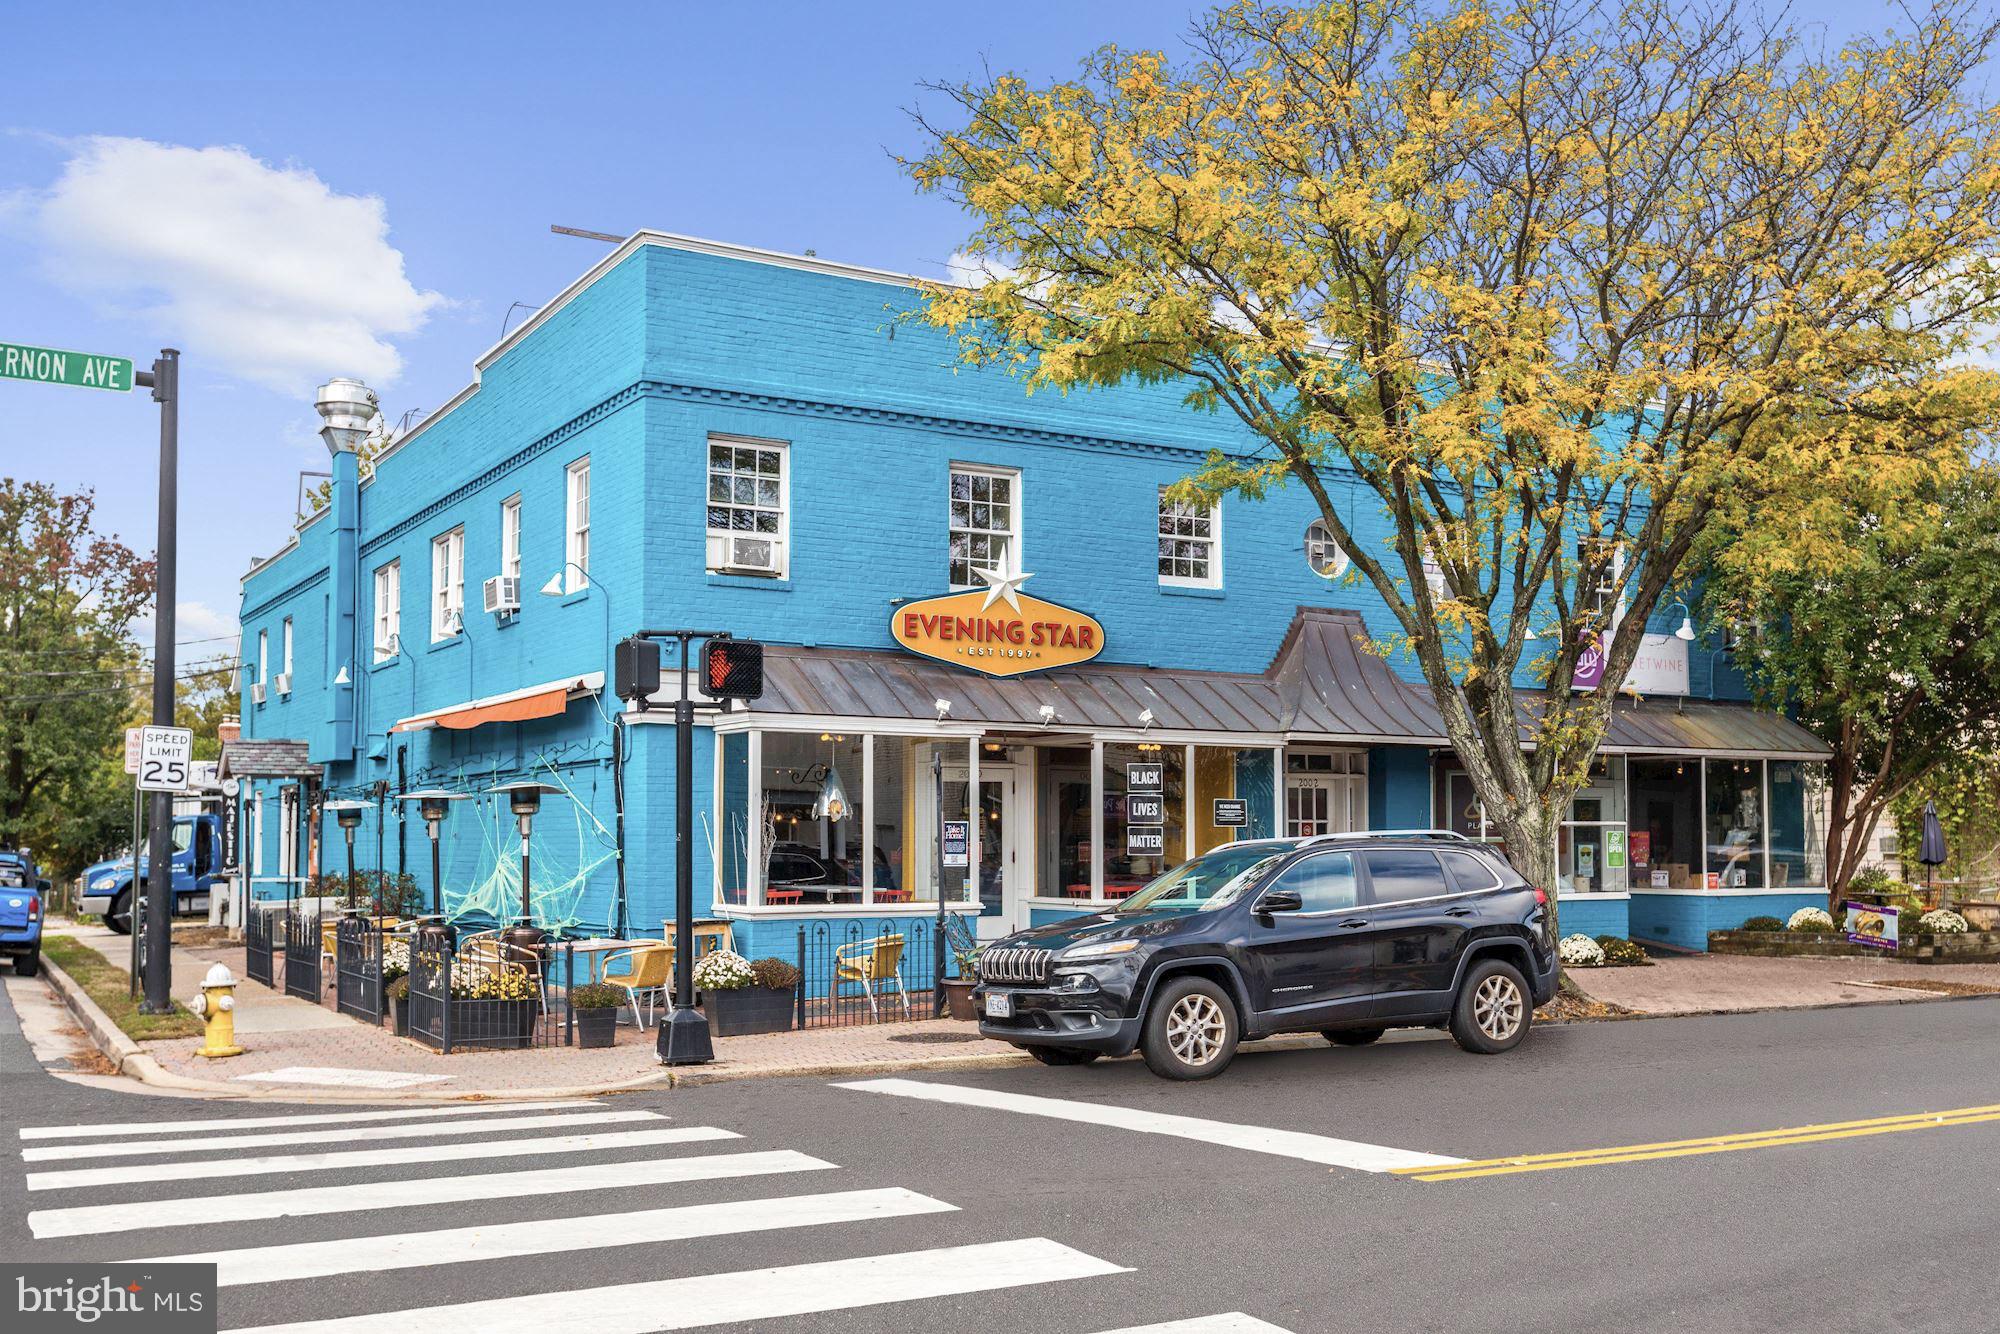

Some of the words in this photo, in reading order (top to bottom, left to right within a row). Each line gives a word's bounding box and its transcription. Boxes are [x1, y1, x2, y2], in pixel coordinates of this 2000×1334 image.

[0, 346, 66, 381] RNON
[82, 357, 121, 388] AVE
[904, 613, 1025, 646] EVENING
[1030, 622, 1095, 650] STAR
[968, 647, 994, 657] EST
[1000, 649, 1033, 659] 1997
[146, 733, 188, 745] SPEED
[150, 747, 182, 757] LIMIT
[144, 761, 185, 783] 25
[1130, 771, 1160, 785] BLACK
[1299, 778, 1319, 788] 2002
[1133, 802, 1158, 816] LIVES
[1129, 834, 1162, 848] MATTER
[1271, 984, 1314, 993] CHEROKEE
